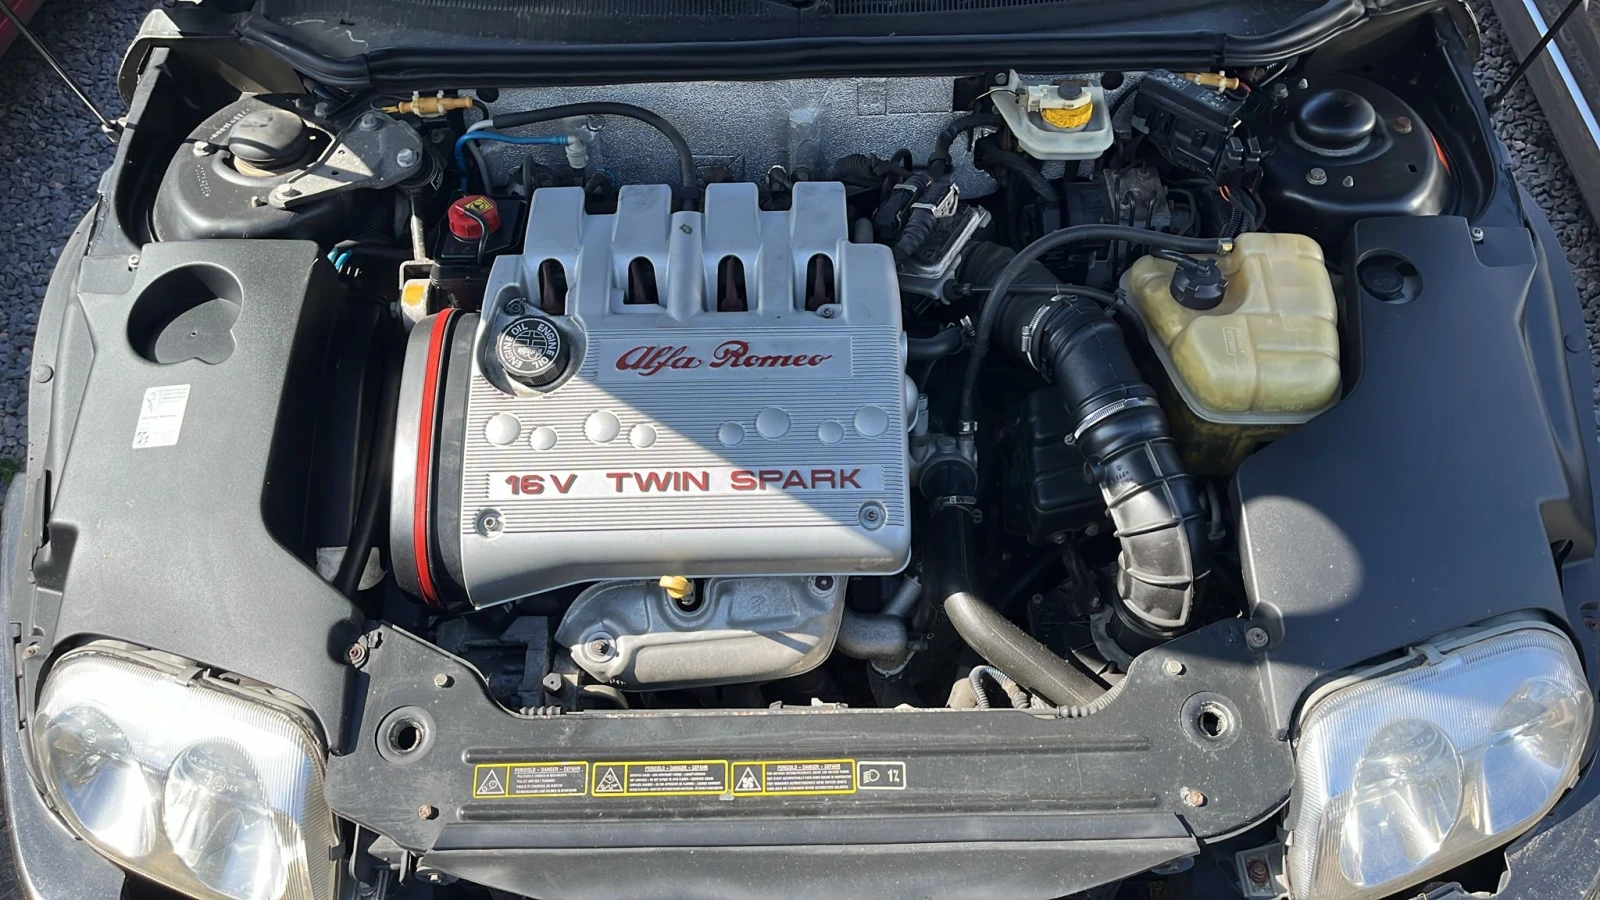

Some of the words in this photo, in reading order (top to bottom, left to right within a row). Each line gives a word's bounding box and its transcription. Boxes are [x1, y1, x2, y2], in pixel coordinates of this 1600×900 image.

[511, 323, 528, 336] OIL
[537, 323, 557, 357] ENGINE
[503, 335, 524, 369] ENGINE
[532, 356, 549, 369] OIL
[615, 345, 702, 377] Alfa
[709, 340, 832, 368] Romeo
[606, 472, 710, 493] TWIN
[730, 468, 862, 492] SPARK
